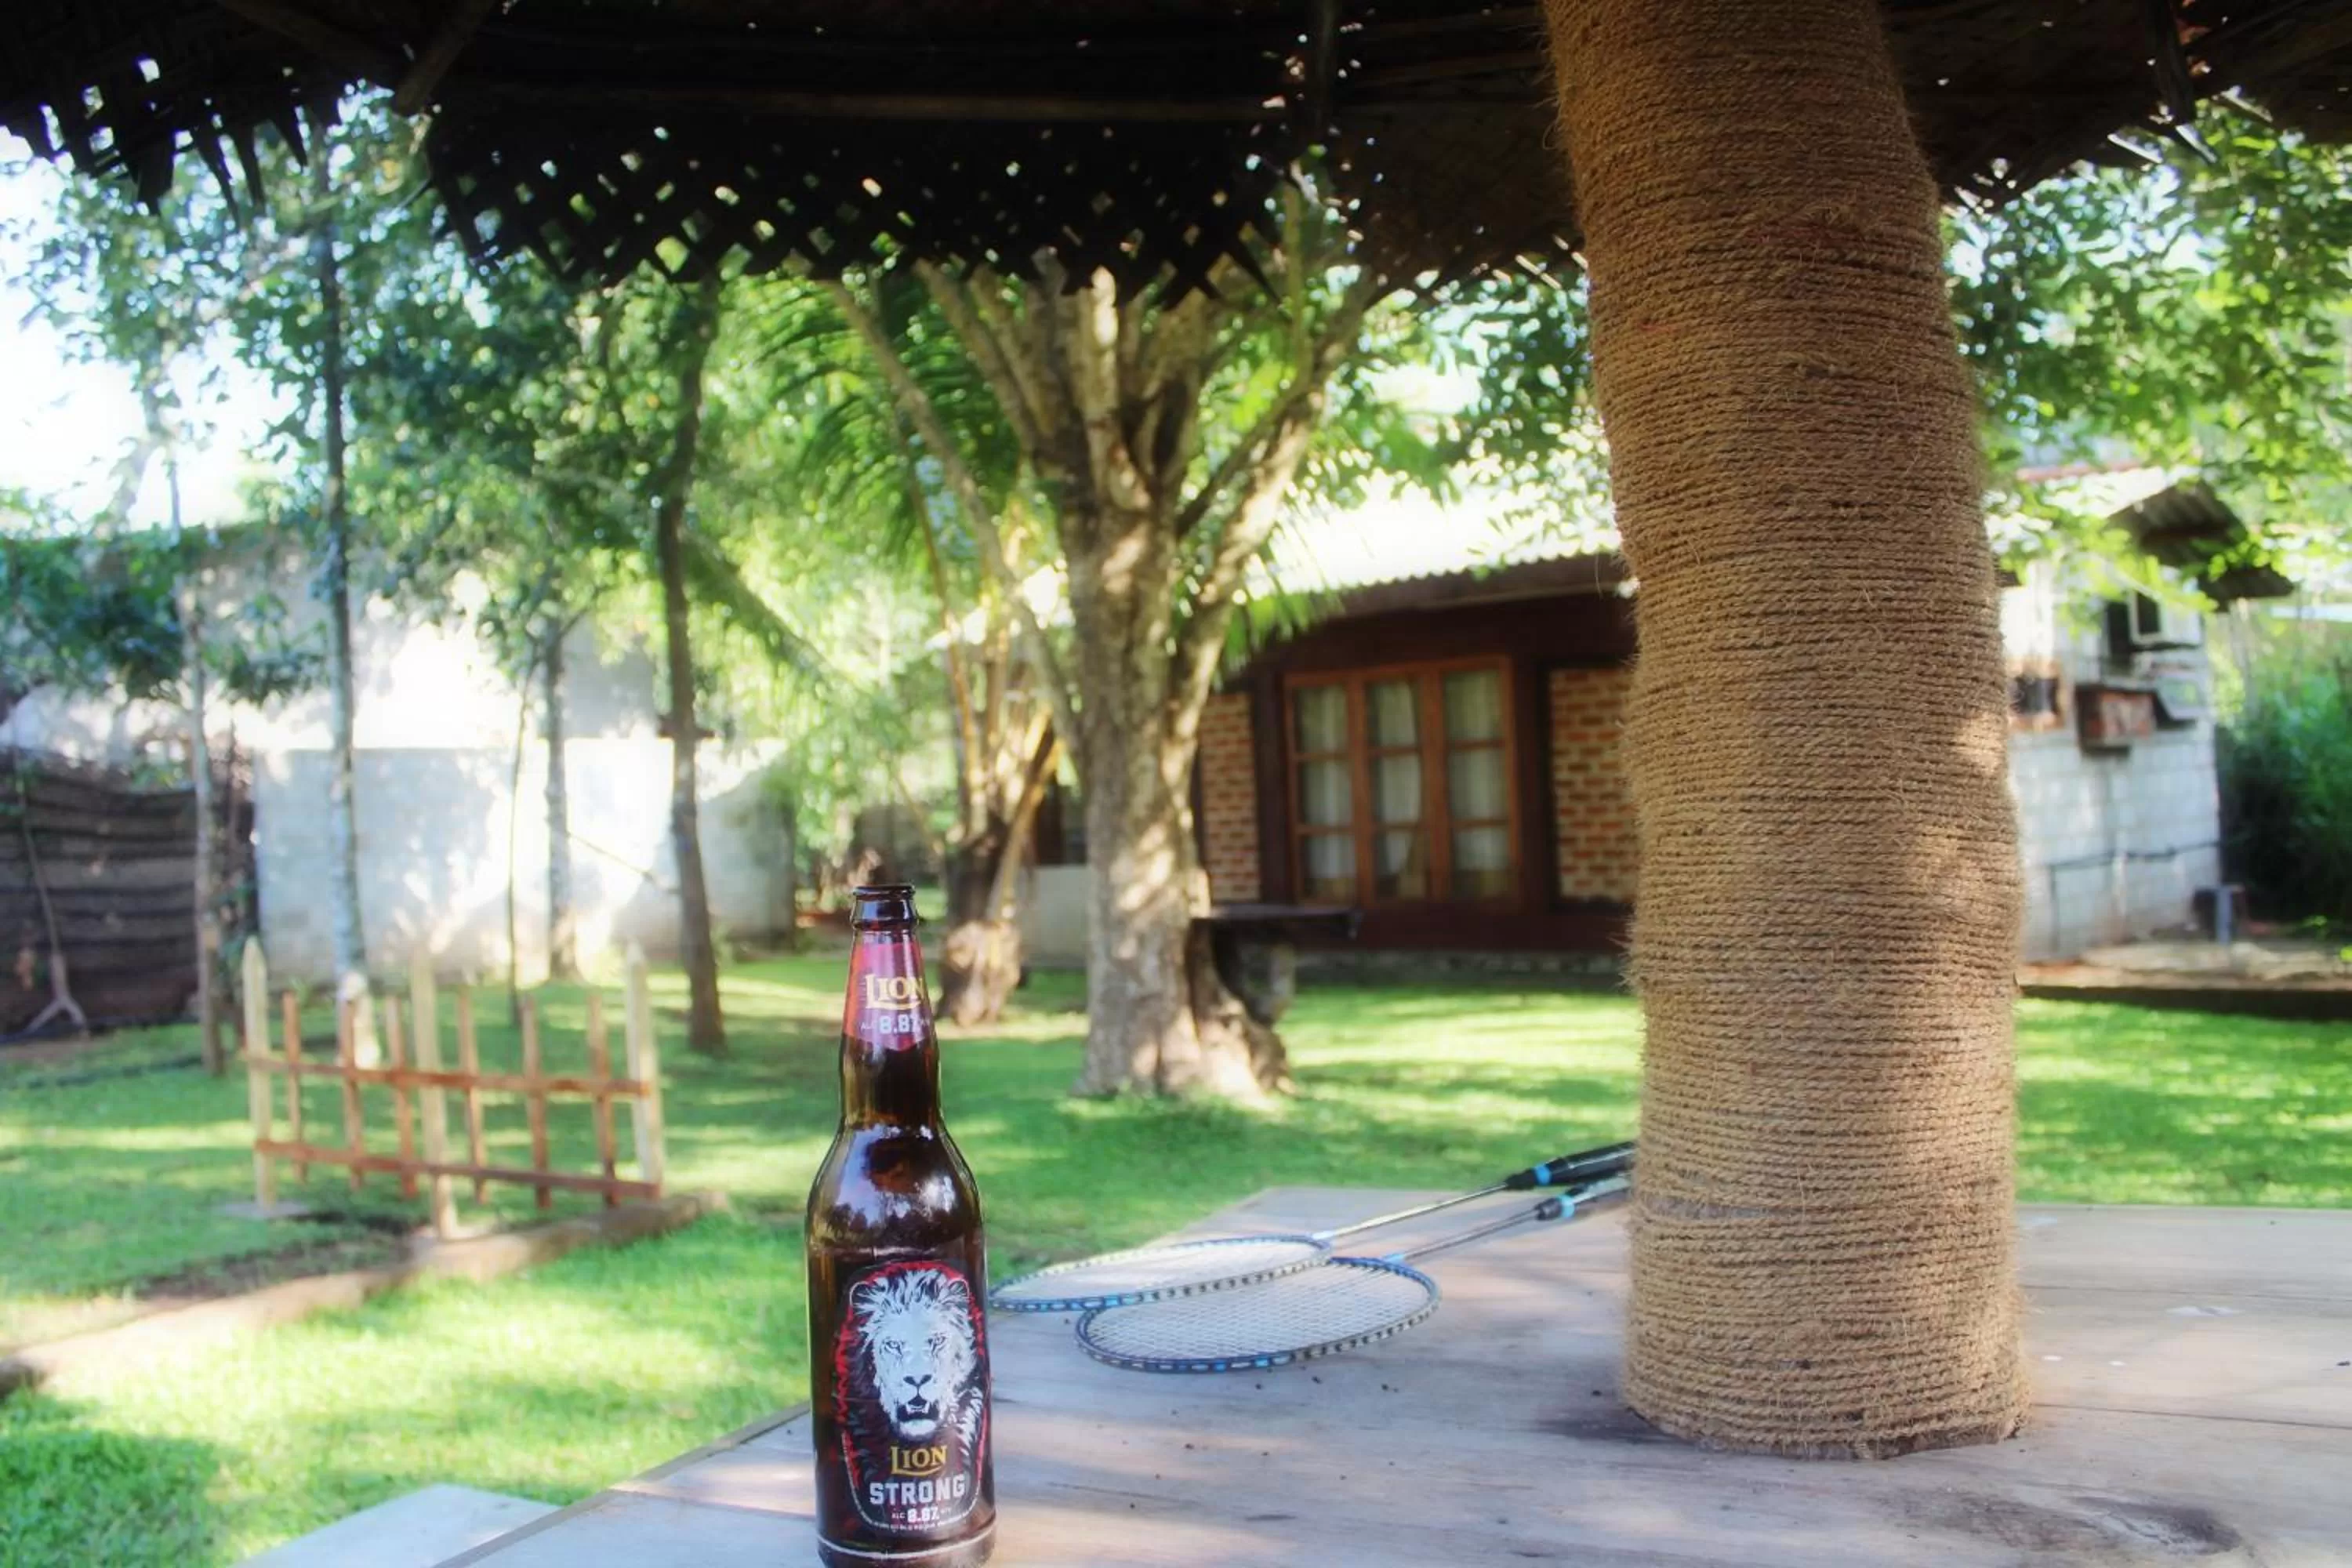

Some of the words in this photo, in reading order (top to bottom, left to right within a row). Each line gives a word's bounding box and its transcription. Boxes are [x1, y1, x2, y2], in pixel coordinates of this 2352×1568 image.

[865, 973, 923, 1010] LION
[891, 1445, 947, 1476] LION
[869, 1474, 965, 1505] STRONG
